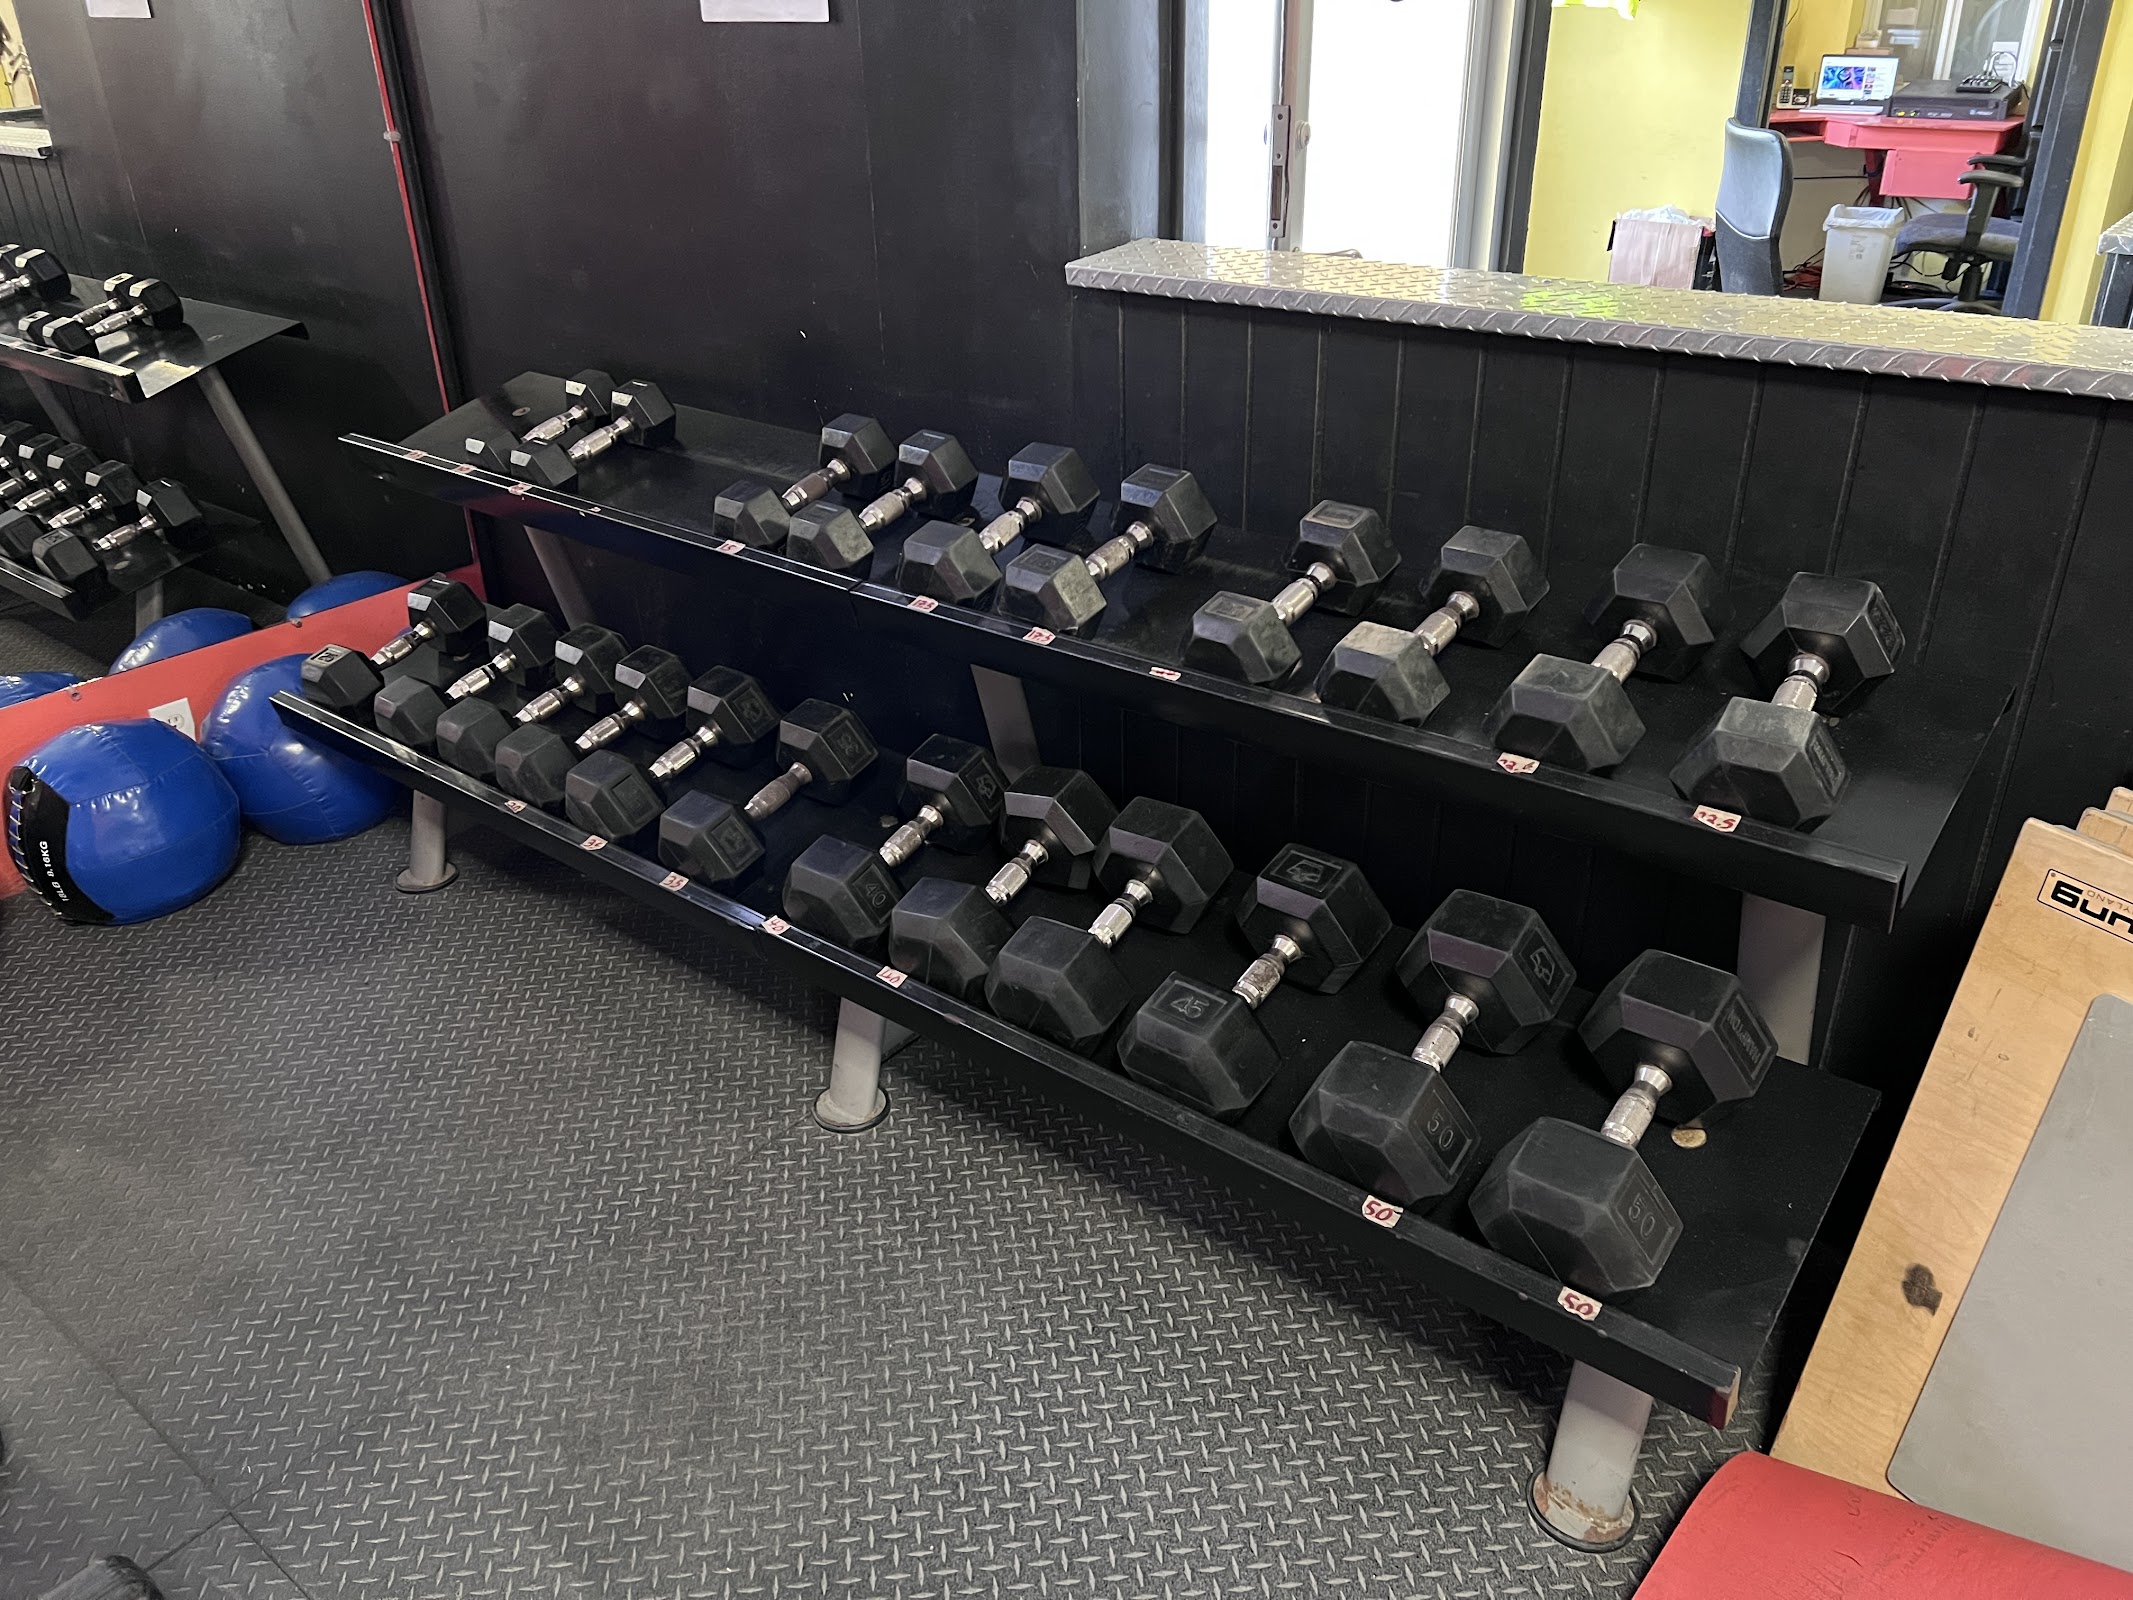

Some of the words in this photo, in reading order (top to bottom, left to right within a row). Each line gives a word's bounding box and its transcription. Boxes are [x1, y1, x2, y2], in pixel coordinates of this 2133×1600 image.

[1027, 629, 1053, 642] 17.5
[664, 876, 684, 888] 35
[866, 883, 888, 908] 40
[2087, 889, 2133, 915] YLAND
[769, 918, 785, 932] 40
[880, 971, 901, 984] 40
[1170, 996, 1209, 1018] 45
[1425, 1111, 1455, 1151] 50
[1366, 1200, 1393, 1221] 50
[1627, 1196, 1656, 1238] 50
[1565, 1292, 1593, 1316] 50
